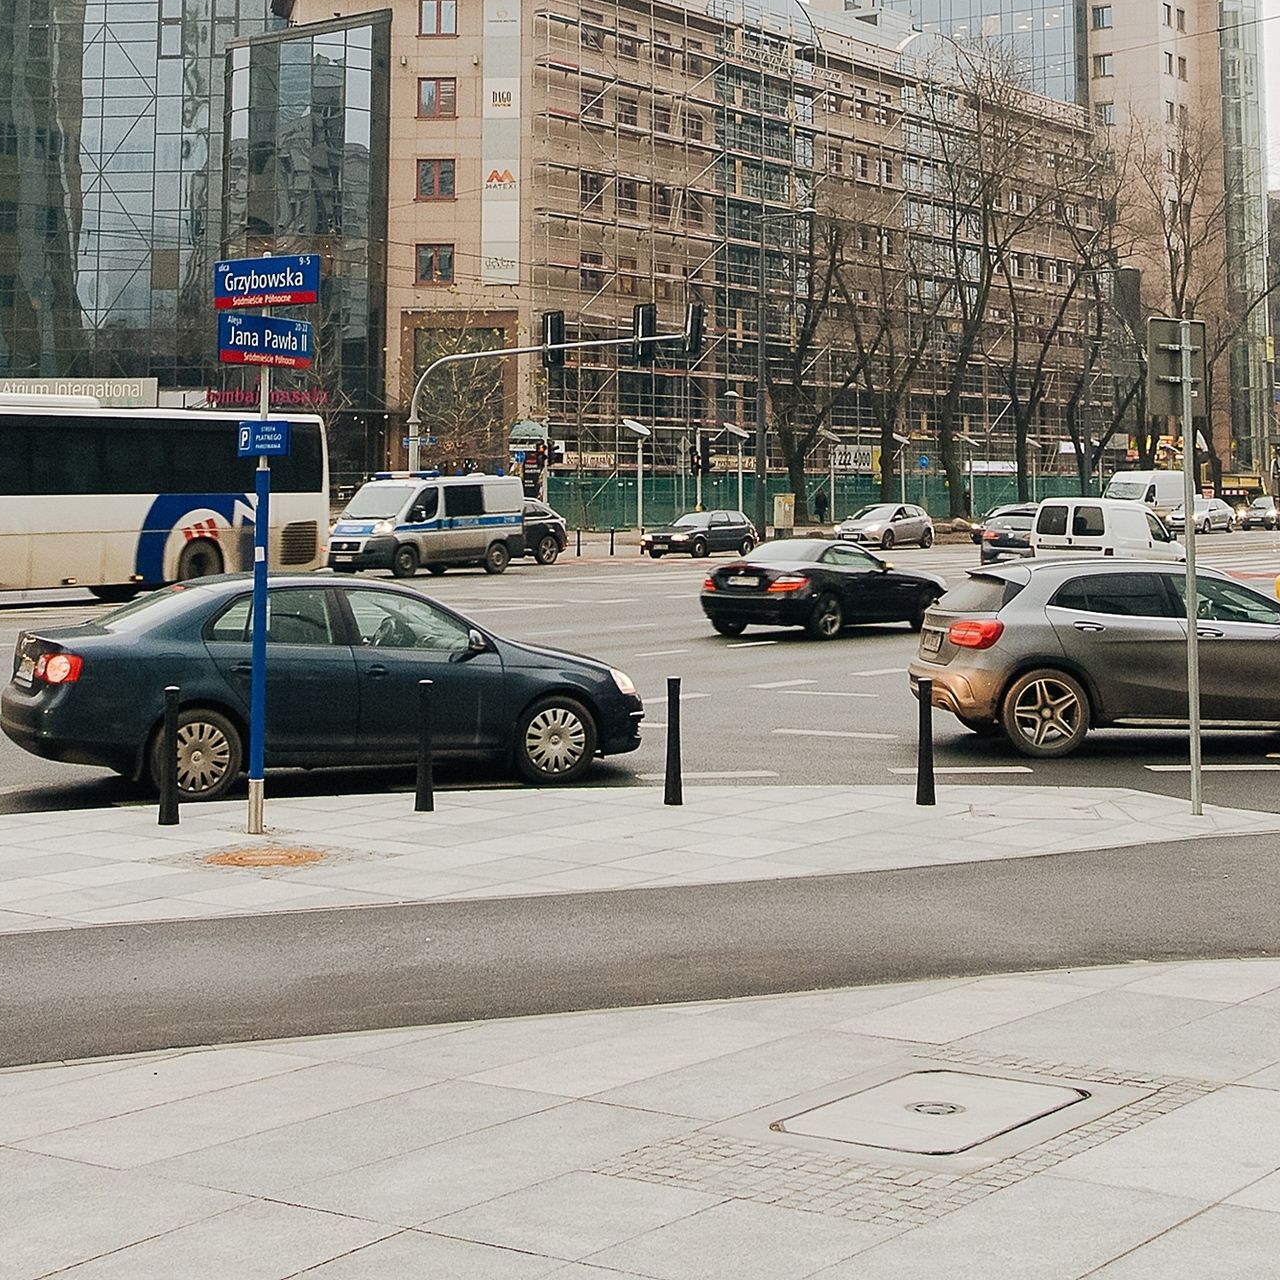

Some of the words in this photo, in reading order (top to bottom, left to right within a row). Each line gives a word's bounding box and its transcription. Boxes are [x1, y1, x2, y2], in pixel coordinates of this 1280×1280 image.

[218, 264, 230, 272] ulica
[298, 256, 311, 266] 9-5
[224, 266, 304, 295] Grzybowska
[227, 315, 243, 327] Aleja
[229, 326, 259, 347] Jana
[264, 329, 298, 351] Pawła
[301, 334, 307, 352] II
[2, 381, 50, 395] Atrium
[54, 380, 144, 398] International
